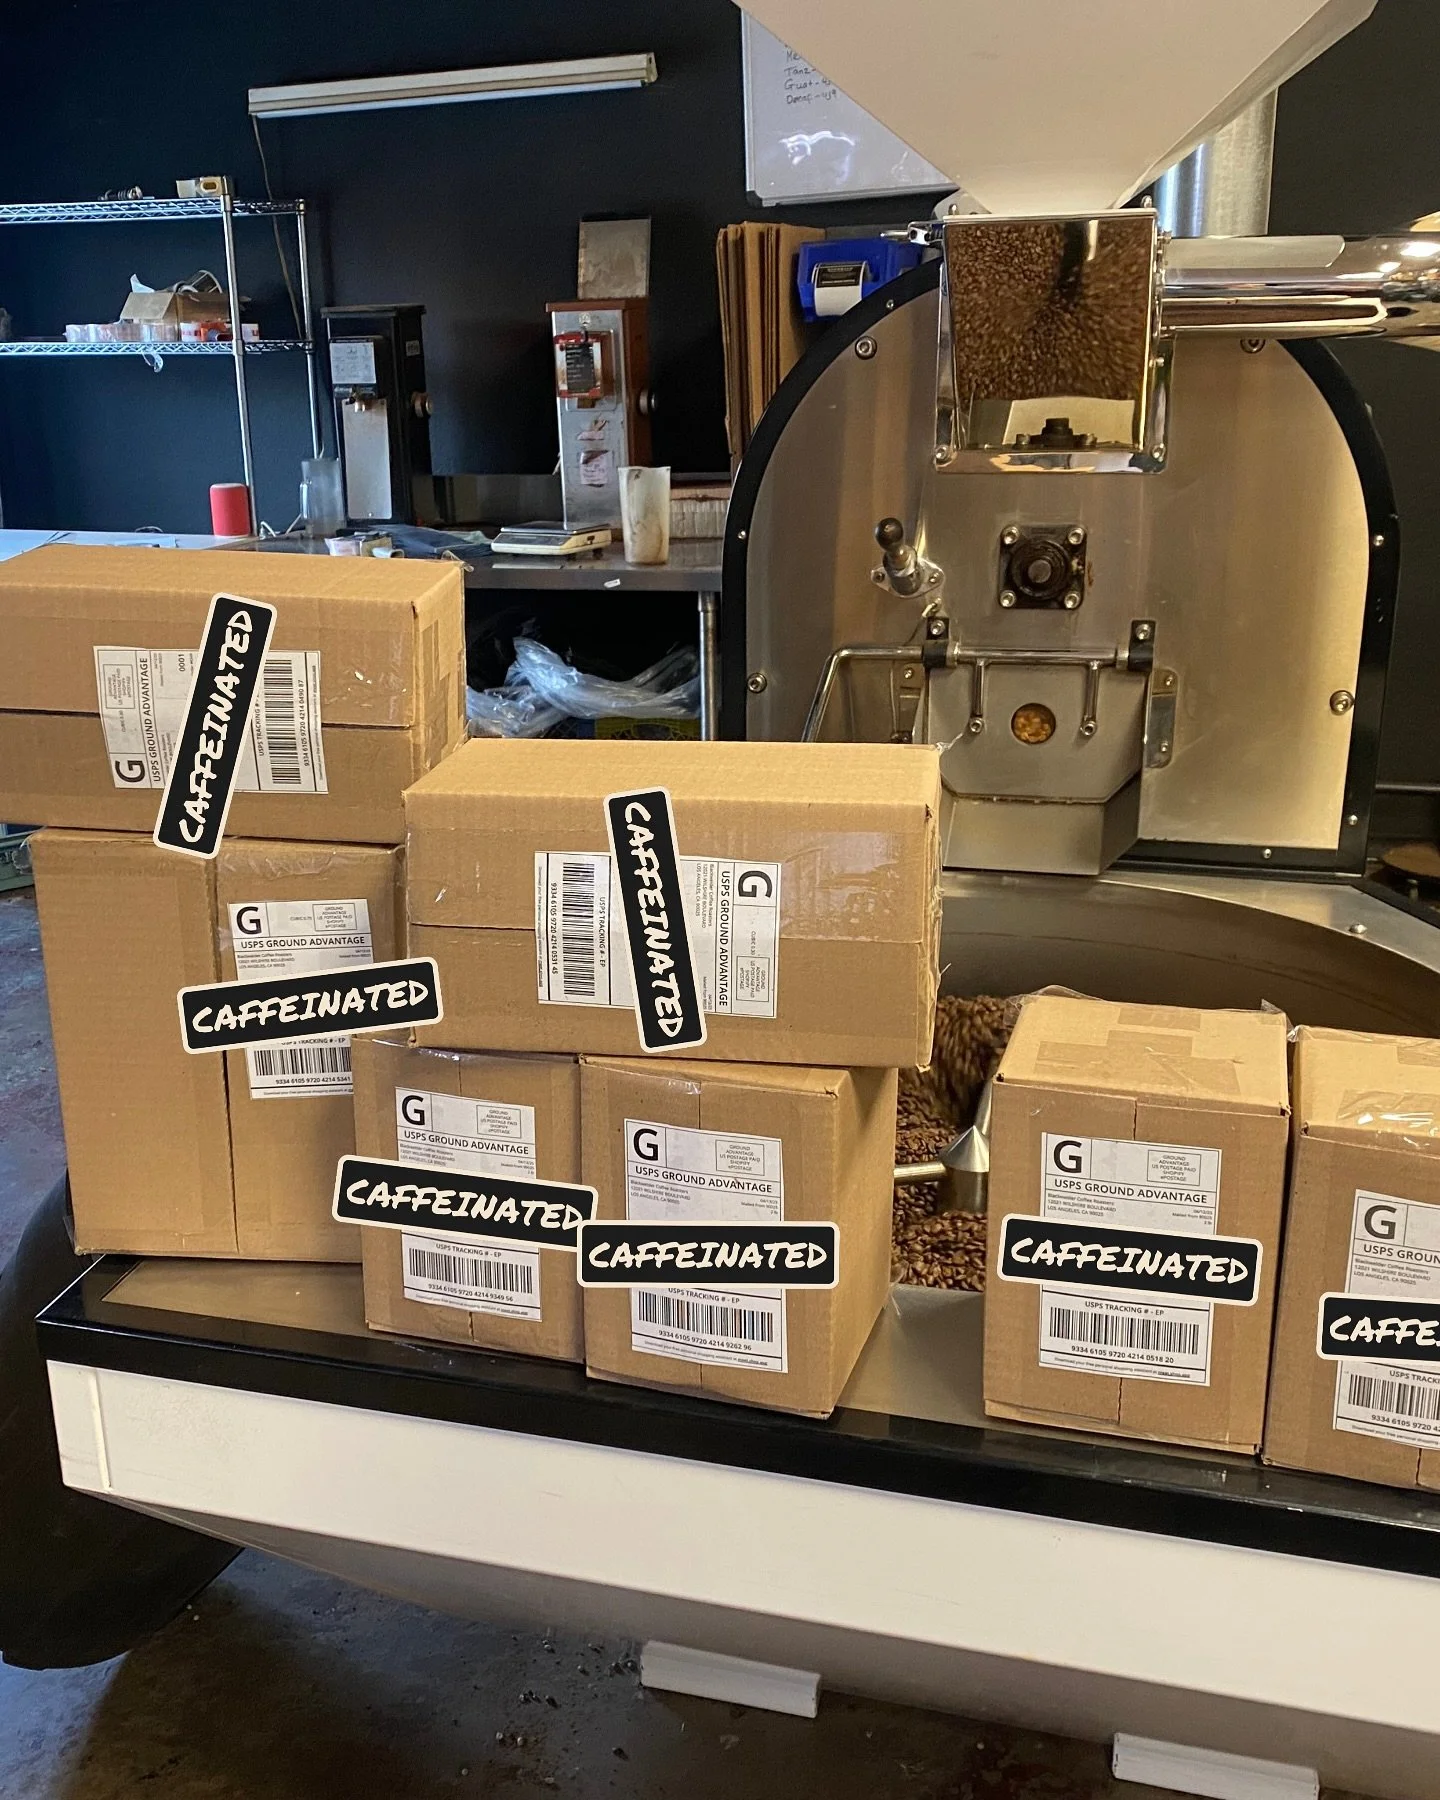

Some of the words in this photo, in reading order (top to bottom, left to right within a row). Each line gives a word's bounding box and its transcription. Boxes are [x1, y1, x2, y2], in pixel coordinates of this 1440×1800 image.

[140, 658, 152, 716] ADVANTAGE
[254, 709, 262, 740] TRACKING
[144, 718, 156, 758] GROUND
[114, 760, 146, 783] G
[150, 760, 161, 782] USPS
[721, 871, 730, 896] USPS
[738, 870, 772, 898] G
[237, 906, 262, 934] G
[720, 899, 730, 945] GROUND
[266, 938, 307, 947] GROUND
[309, 937, 365, 945] ADVANTAGE
[719, 947, 728, 1006] ADVANTAGE
[402, 1095, 425, 1125] G
[404, 1130, 426, 1141] USPS
[429, 1134, 468, 1147] GROUND
[471, 1141, 529, 1155] ADVANTAGE
[633, 1128, 658, 1161] G
[1053, 1140, 1082, 1173] G
[635, 1166, 660, 1177] USPS
[662, 1170, 706, 1185] GROUND
[709, 1178, 772, 1193] ADVANTAGE
[1055, 1179, 1081, 1190] USPS
[1085, 1183, 1134, 1197] GROUND
[1137, 1190, 1207, 1203] ADVANTAGE
[1364, 1205, 1397, 1239] G
[436, 1243, 451, 1251] USPS
[452, 1246, 483, 1256] TRACKING
[1364, 1244, 1393, 1256] USPS
[668, 1288, 685, 1296] USPS
[686, 1291, 720, 1301] TRACKING
[1085, 1301, 1104, 1309] USPS
[1106, 1303, 1142, 1314] TRACKING
[659, 1330, 674, 1338] 9334
[675, 1333, 690, 1341] 6105
[692, 1337, 706, 1345] 9720
[1072, 1346, 1088, 1354] 9334
[1090, 1348, 1106, 1356] 6105
[1390, 1370, 1410, 1379] USPS
[1372, 1414, 1390, 1423] 9334
[1392, 1418, 1410, 1427] 6105
[1413, 1422, 1431, 1430] 9720
